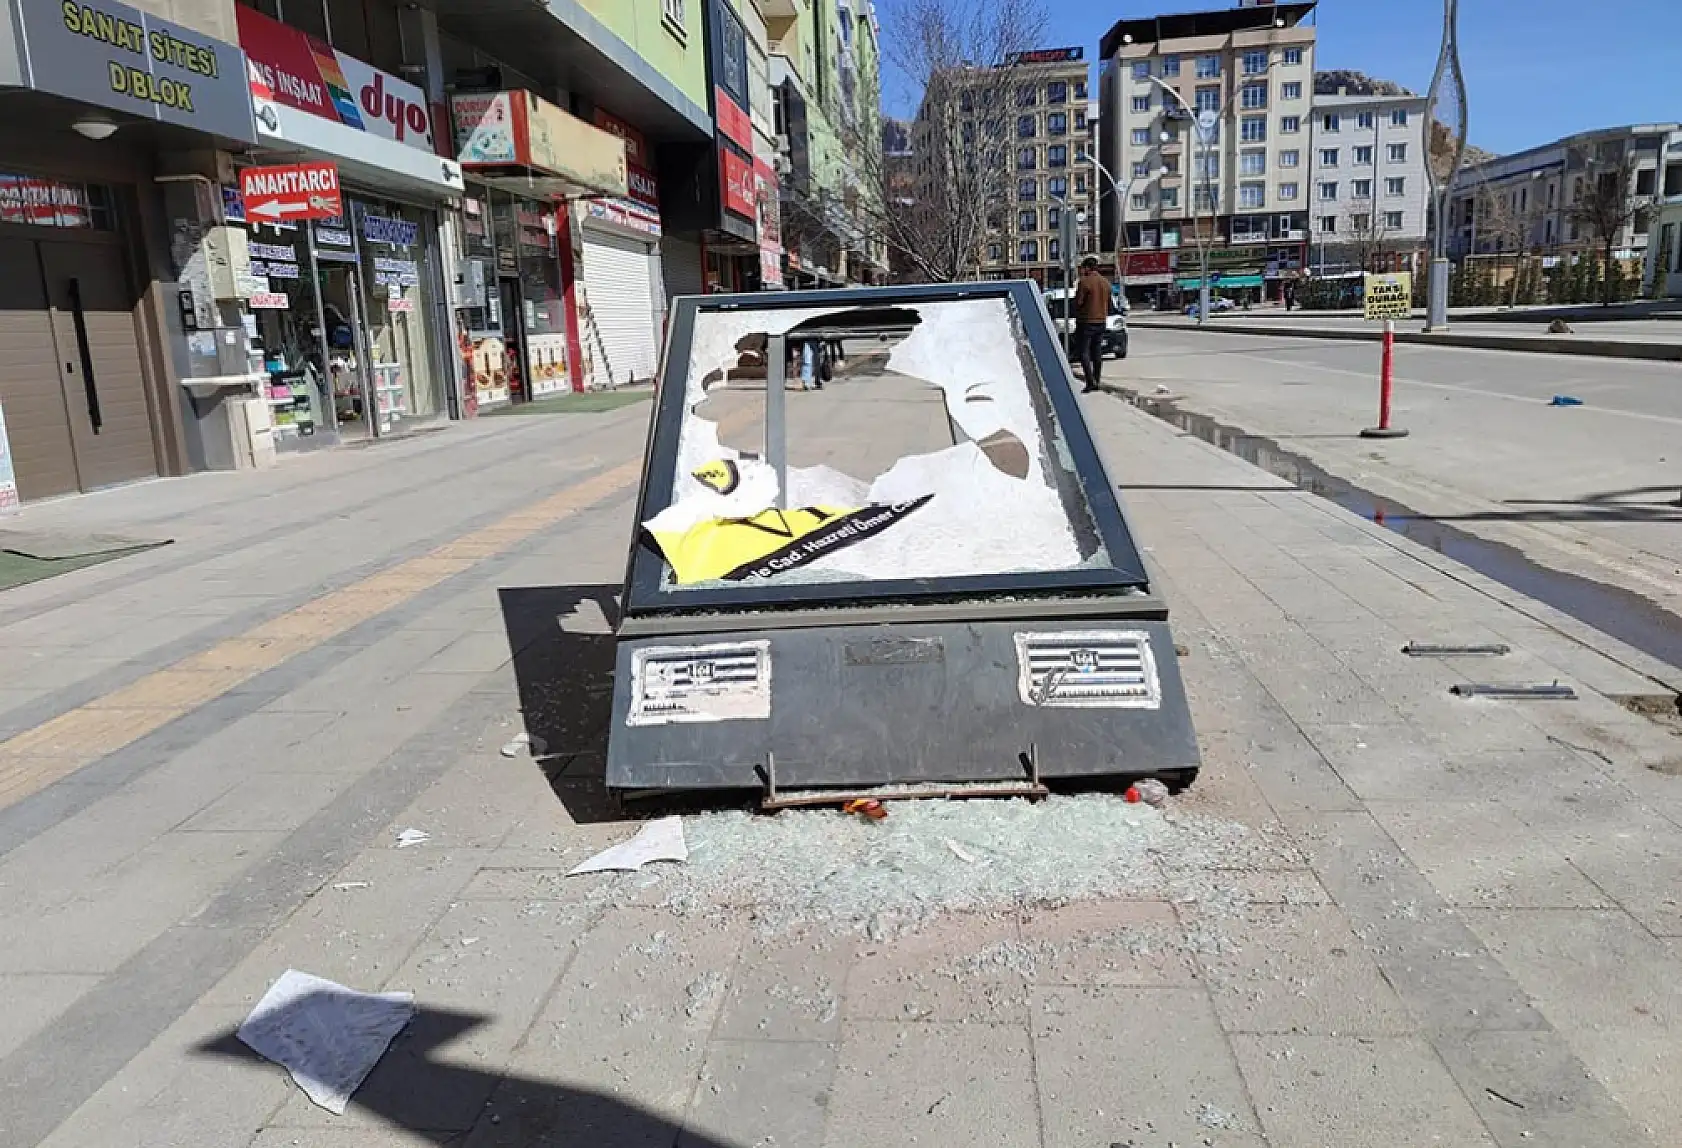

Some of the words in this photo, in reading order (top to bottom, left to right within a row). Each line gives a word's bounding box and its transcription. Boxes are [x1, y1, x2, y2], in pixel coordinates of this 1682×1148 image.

[62, 0, 144, 54] SANAT
[150, 28, 219, 79] SİTESİ
[360, 71, 428, 142] dyo
[245, 168, 336, 196] ANAHTARCI
